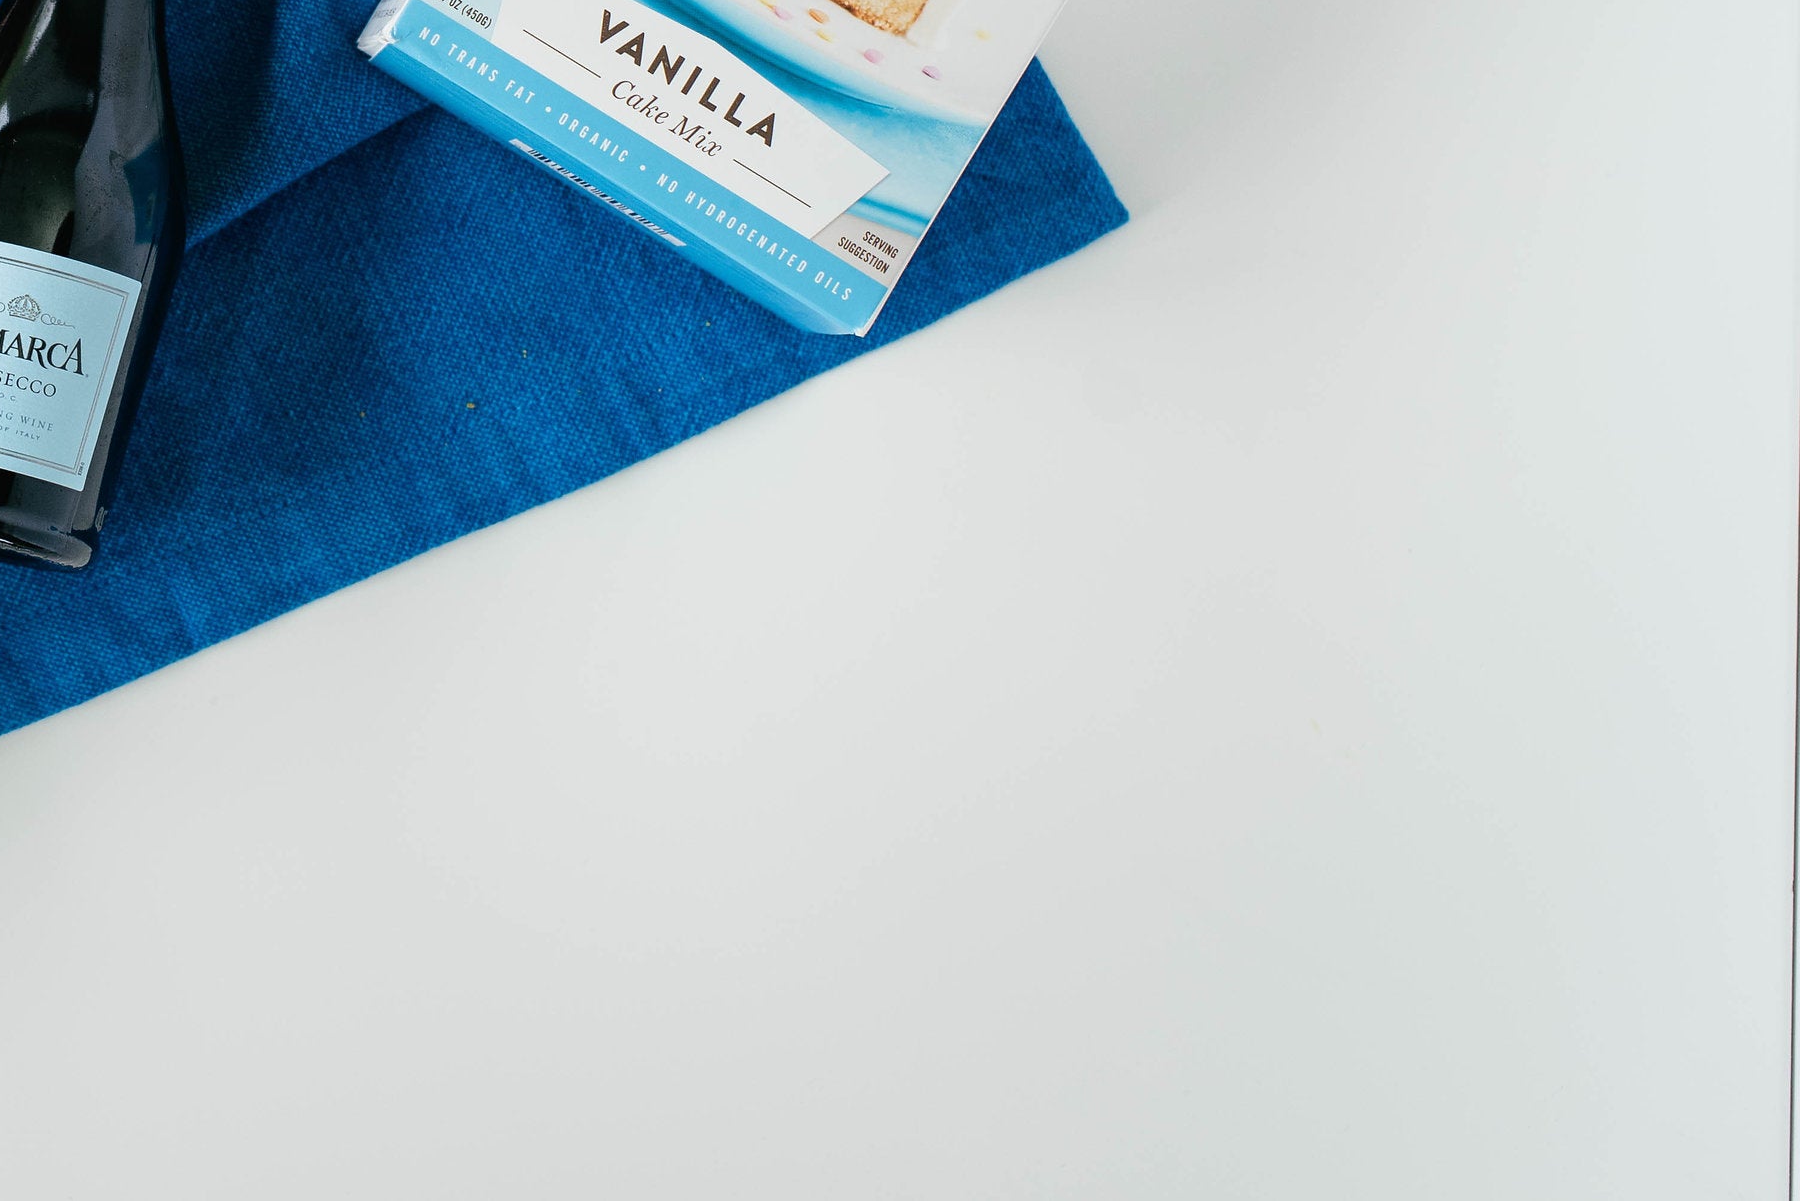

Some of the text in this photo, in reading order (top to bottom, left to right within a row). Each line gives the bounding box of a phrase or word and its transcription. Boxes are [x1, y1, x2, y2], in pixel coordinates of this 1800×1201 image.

[461, 4, 492, 30] (450G)
[600, 9, 775, 147] VANILLA
[611, 80, 722, 157] Cake Mix
[419, 26, 852, 301] NO TRANS FAT ORGANIC NO HYDROGENATED OILS
[837, 236, 890, 274] SUGGESTION
[862, 231, 899, 259] SERVING
[15, 429, 41, 440] ITALY
[20, 415, 54, 432] WINE
